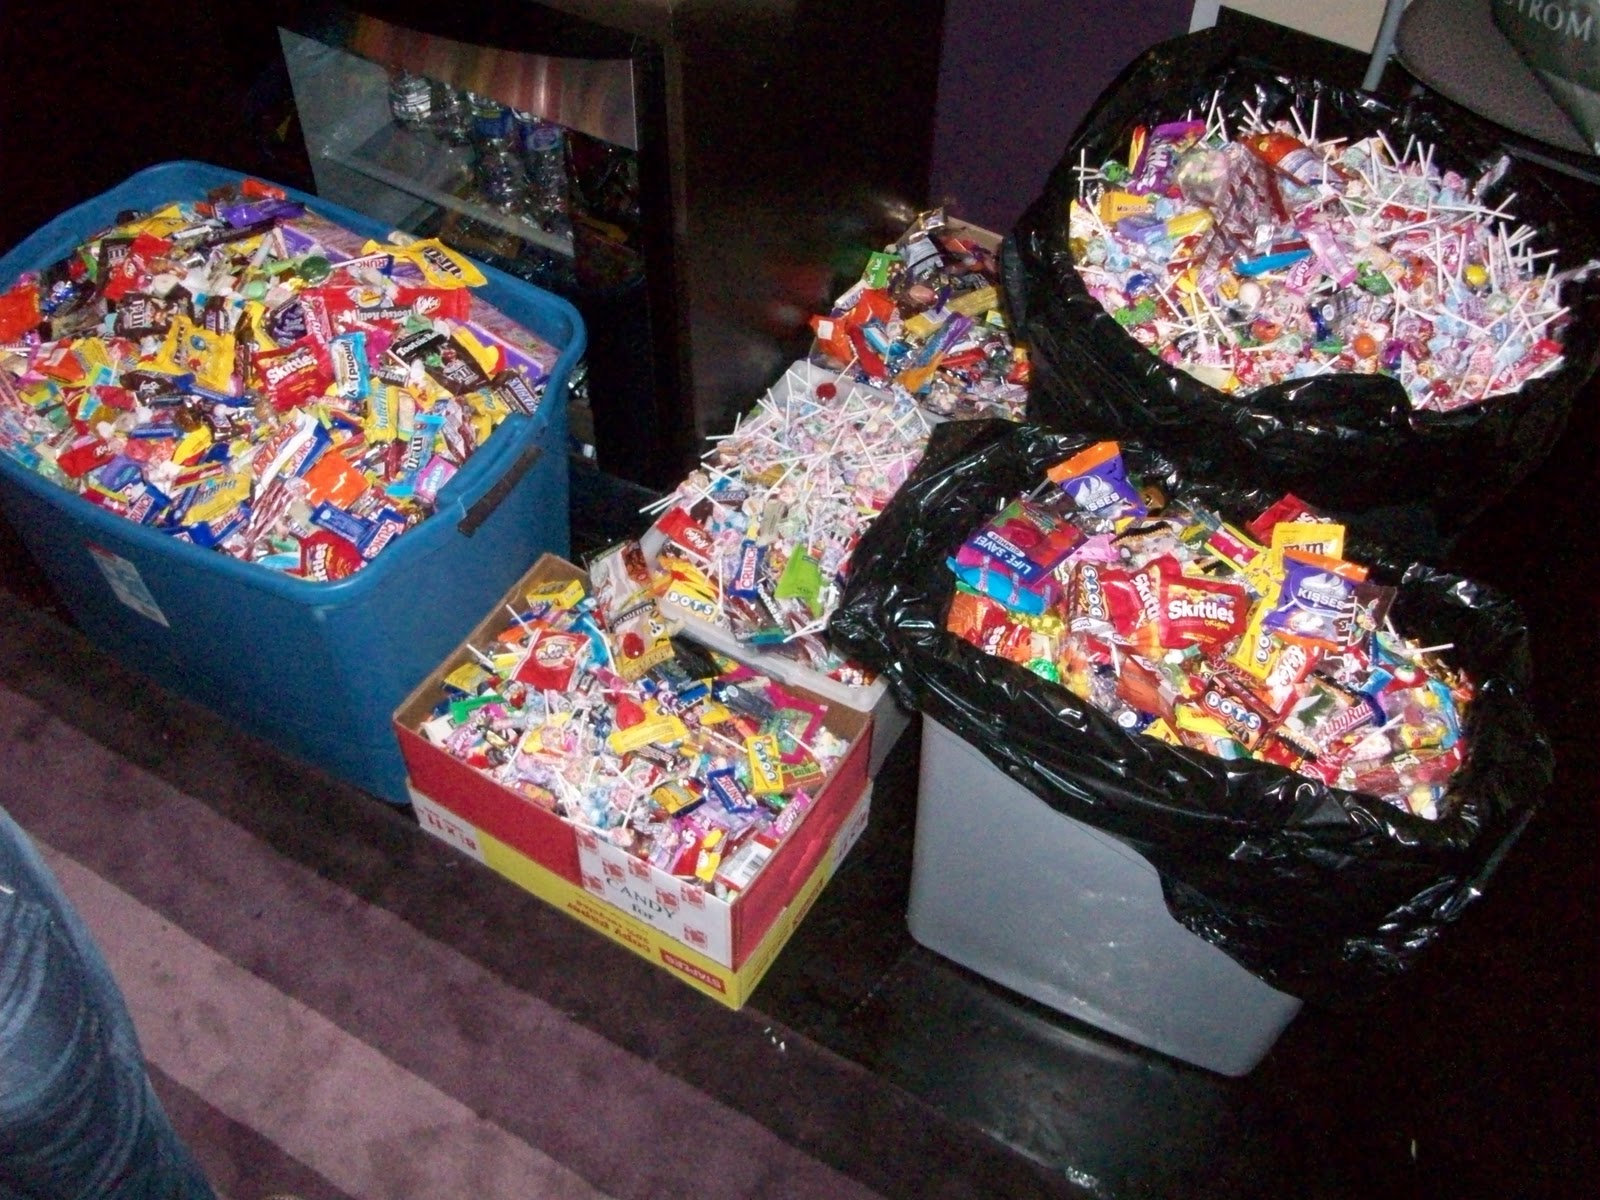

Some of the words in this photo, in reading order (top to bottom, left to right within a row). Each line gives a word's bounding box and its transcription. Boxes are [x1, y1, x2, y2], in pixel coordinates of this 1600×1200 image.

[1005, 554, 1033, 575] LIFE
[668, 590, 715, 617] DOTS
[1082, 566, 1104, 618] DOTS
[1297, 587, 1346, 611] KISSES
[1168, 599, 1235, 625] Skittles
[1206, 691, 1261, 732] DOTS
[753, 741, 778, 781] DOTS
[606, 877, 678, 919] CANDY
[632, 903, 655, 921] for
[663, 954, 723, 990] STAPLES
